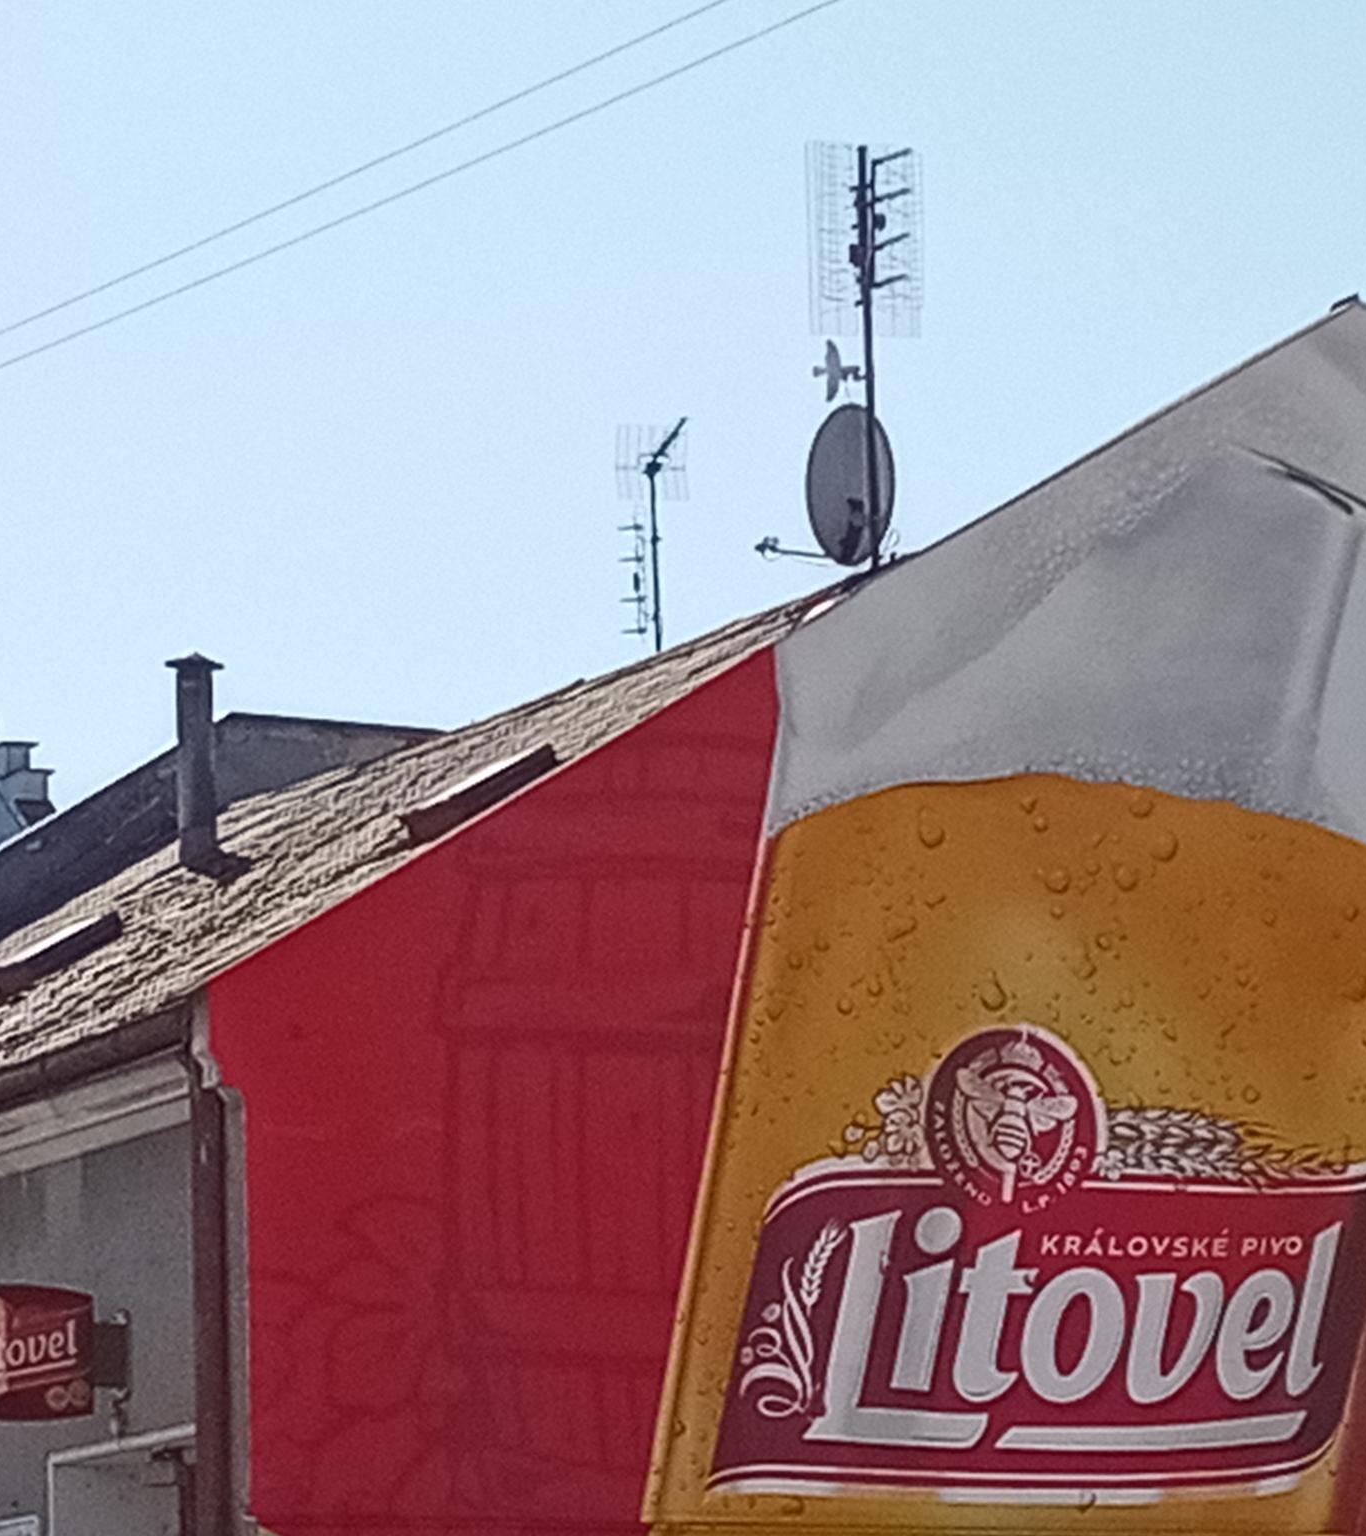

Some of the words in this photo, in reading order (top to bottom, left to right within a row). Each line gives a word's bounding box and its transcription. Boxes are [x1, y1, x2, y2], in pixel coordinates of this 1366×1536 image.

[1040, 1227, 1230, 1258] KRÁLOVSKÉ
[1240, 1235, 1303, 1257] PIVO
[802, 1206, 1343, 1451] Litovel
